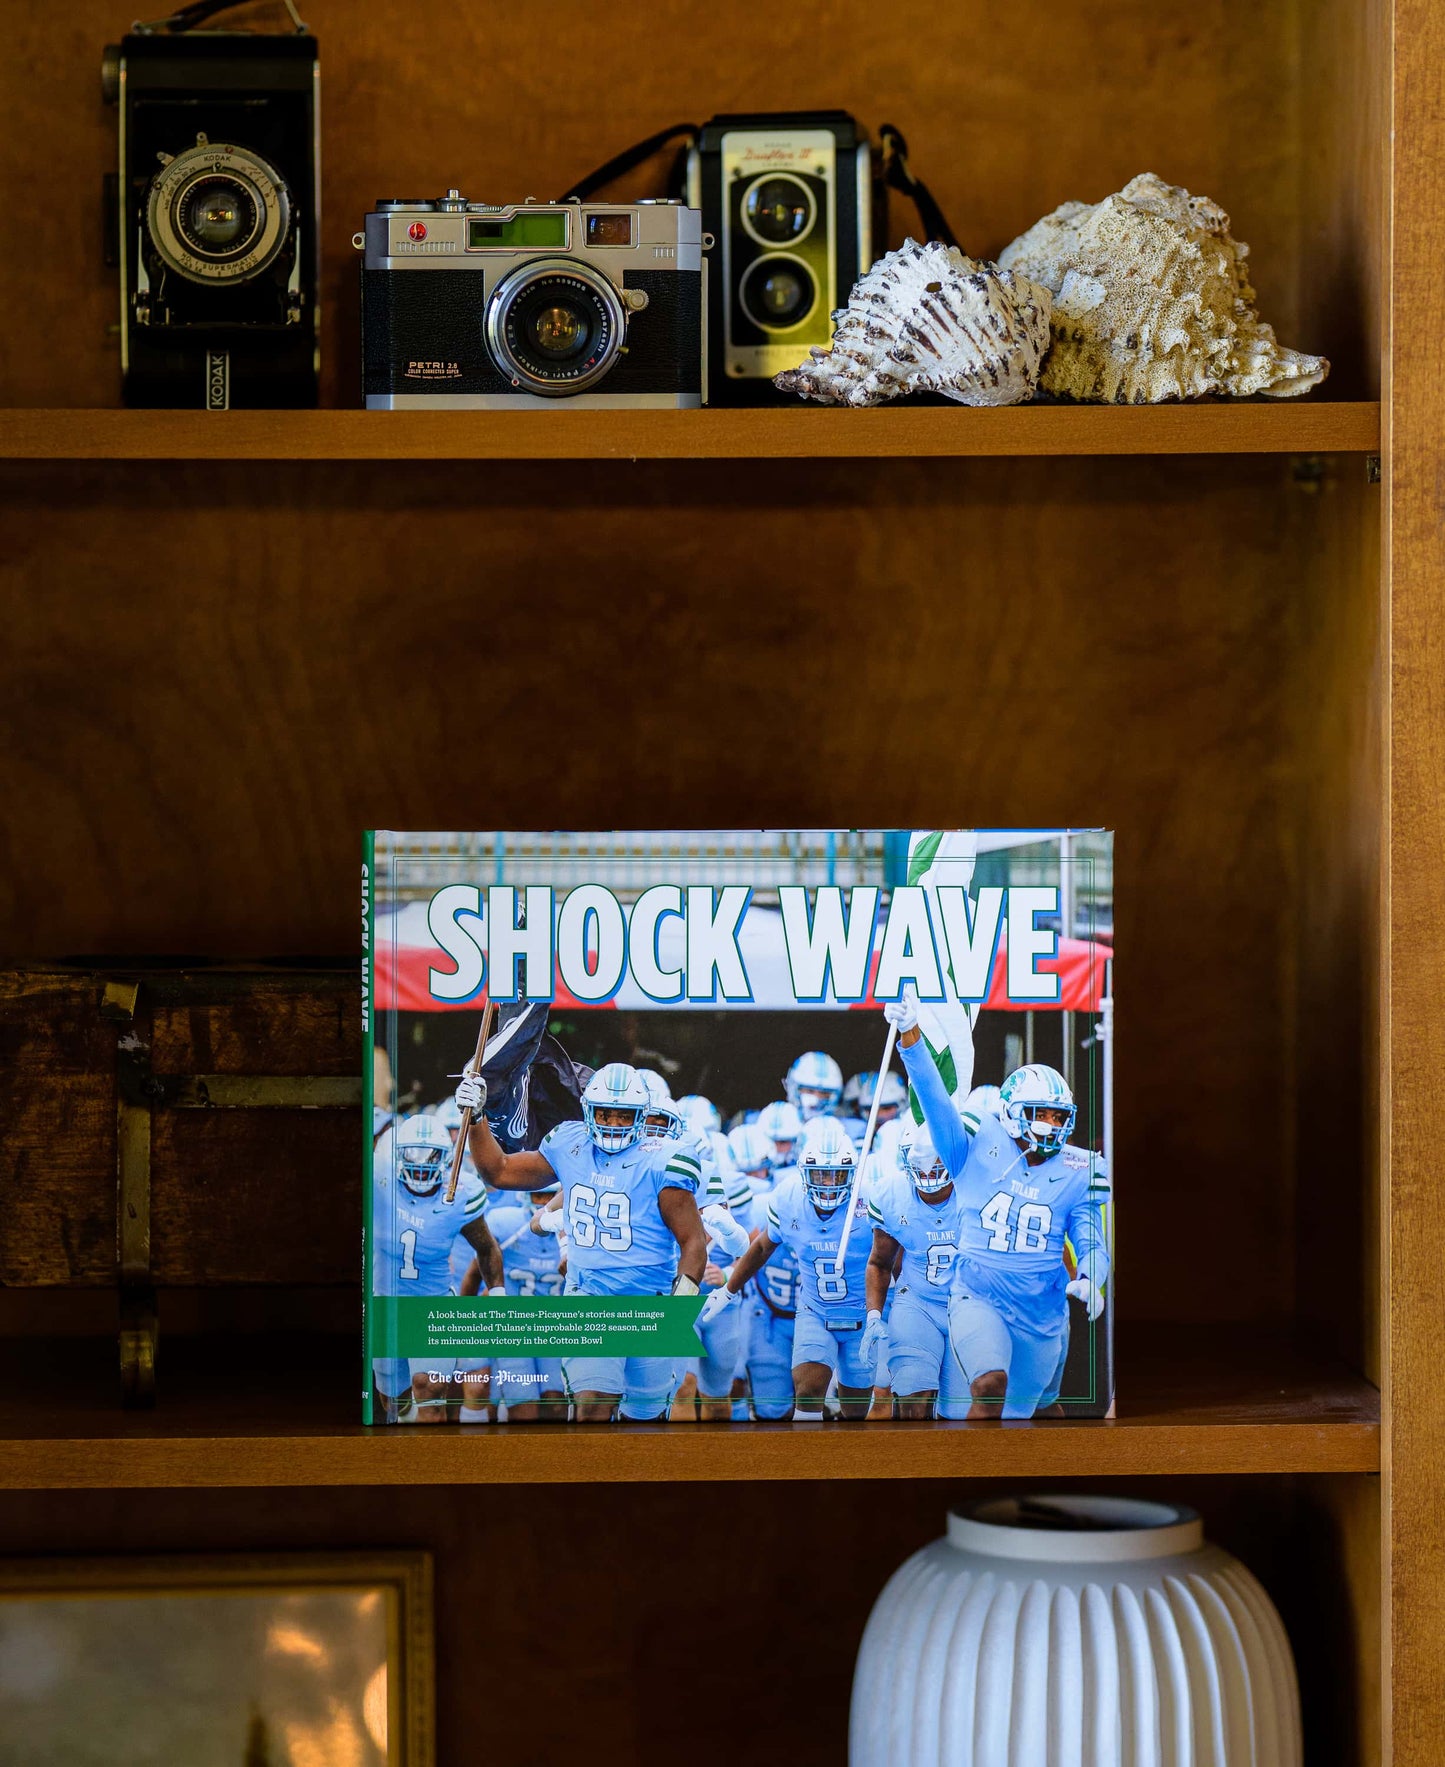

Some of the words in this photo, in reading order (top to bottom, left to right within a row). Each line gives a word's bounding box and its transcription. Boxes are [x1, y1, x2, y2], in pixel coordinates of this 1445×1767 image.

[409, 361, 444, 369] PETRI
[211, 355, 224, 406] KODAK
[427, 884, 755, 1003] SHOCK
[777, 885, 1062, 1003] WAVE
[1010, 1179, 1040, 1200] TULANE
[568, 1182, 633, 1252] 69
[979, 1190, 1053, 1253] 48
[926, 1230, 956, 1241] TULANE
[399, 1228, 420, 1281] 1
[813, 1256, 848, 1301] 8
[428, 1311, 435, 1319] A
[436, 1310, 455, 1319] look
[456, 1310, 477, 1319] back
[489, 1310, 506, 1319] The
[507, 1310, 584, 1320] Times-Picayune's
[585, 1310, 616, 1319] stories
[616, 1310, 633, 1318] and
[634, 1310, 665, 1319] images
[428, 1324, 446, 1332] that
[447, 1324, 494, 1332] chronicled
[495, 1324, 532, 1332] Tulane's
[533, 1323, 583, 1333] improbable
[584, 1323, 607, 1331] 2022
[641, 1323, 658, 1331] and
[428, 1336, 440, 1345] its
[440, 1336, 490, 1345] miraculous
[490, 1336, 522, 1346] victory
[523, 1336, 532, 1345] in
[533, 1336, 548, 1345] the
[549, 1336, 580, 1345] Cotton
[580, 1336, 603, 1345] Bowl
[427, 1370, 451, 1384] The
[452, 1370, 550, 1387] Times-Picayune
